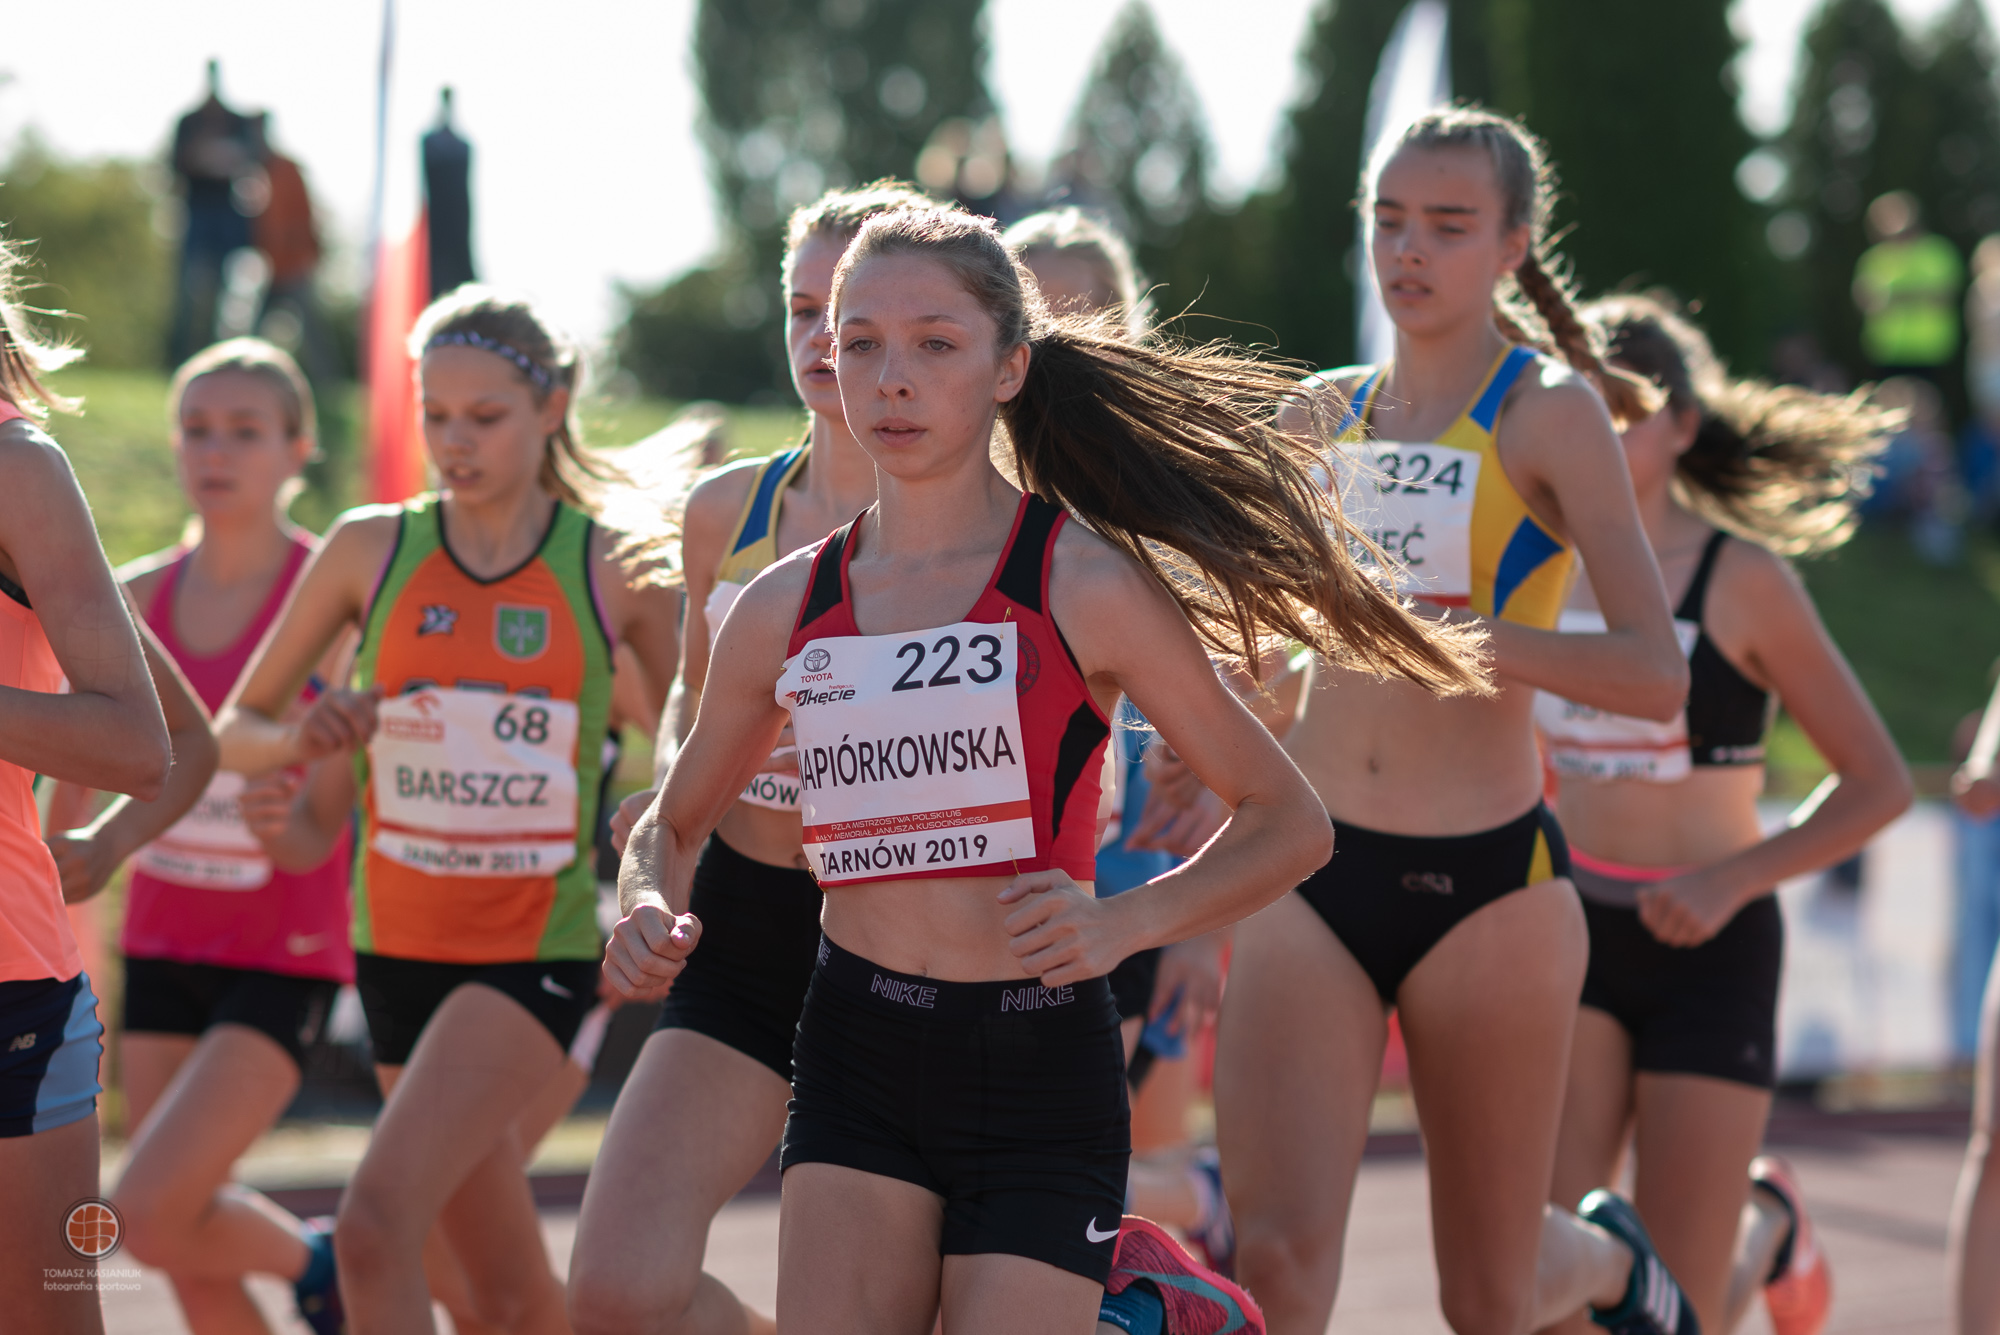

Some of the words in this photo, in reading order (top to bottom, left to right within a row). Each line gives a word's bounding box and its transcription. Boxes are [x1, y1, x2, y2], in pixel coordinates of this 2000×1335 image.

[1376, 453, 1465, 496] 324
[800, 672, 833, 683] TOYOTA
[892, 634, 1003, 692] 223
[494, 704, 550, 745] 68
[396, 765, 548, 807] BARSZCZ
[745, 775, 800, 806] NÓW
[834, 829, 873, 840] MEMORIAŁ
[873, 825, 915, 835] JANUSZA
[916, 815, 989, 830] KUSOCIŃSKIEGO
[852, 816, 911, 829] MISTRZOSTWA
[912, 812, 945, 821] POLSKI
[945, 809, 962, 818] U16
[820, 839, 916, 875] TARNÓW
[925, 834, 988, 864] 2019
[870, 973, 938, 1010] NIKE
[1001, 982, 1075, 1012] NIKE
